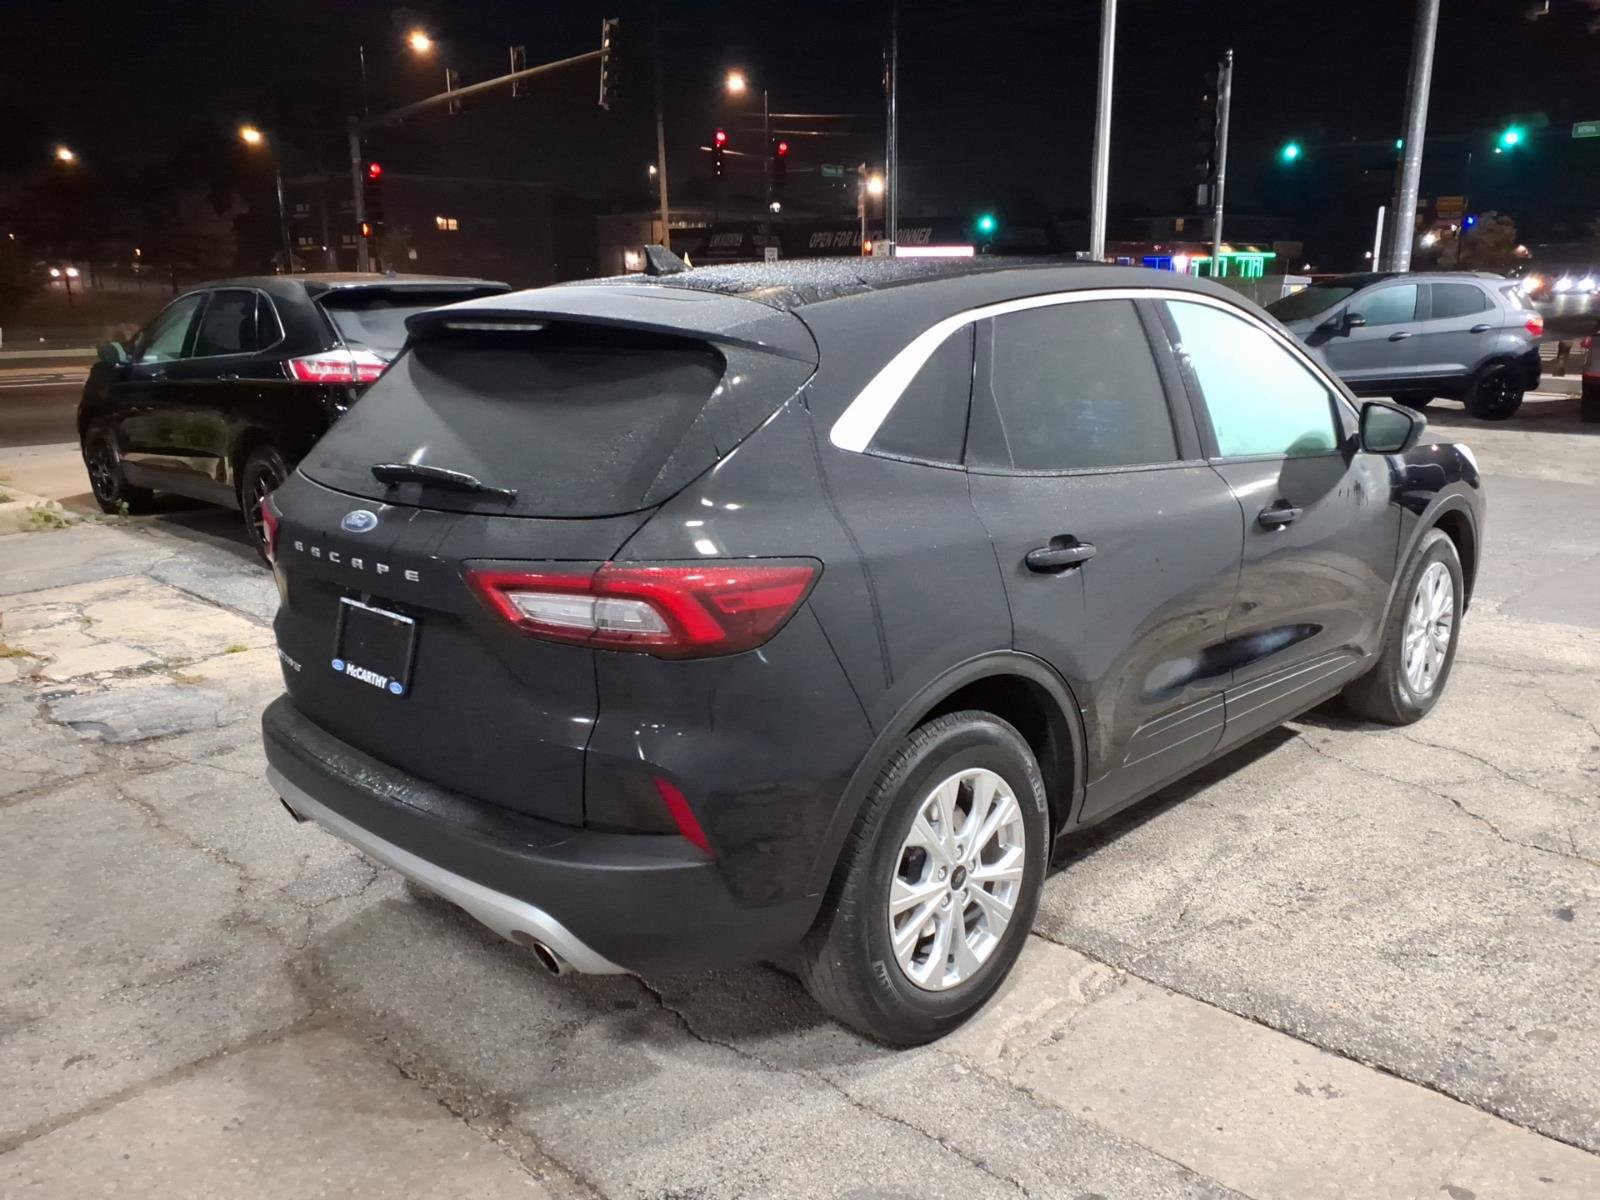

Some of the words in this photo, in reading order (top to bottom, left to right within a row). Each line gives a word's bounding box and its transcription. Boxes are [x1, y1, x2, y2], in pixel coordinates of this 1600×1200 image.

[809, 231, 835, 248] OPEN
[833, 231, 853, 247] FOR
[294, 540, 420, 582] ESCAPE
